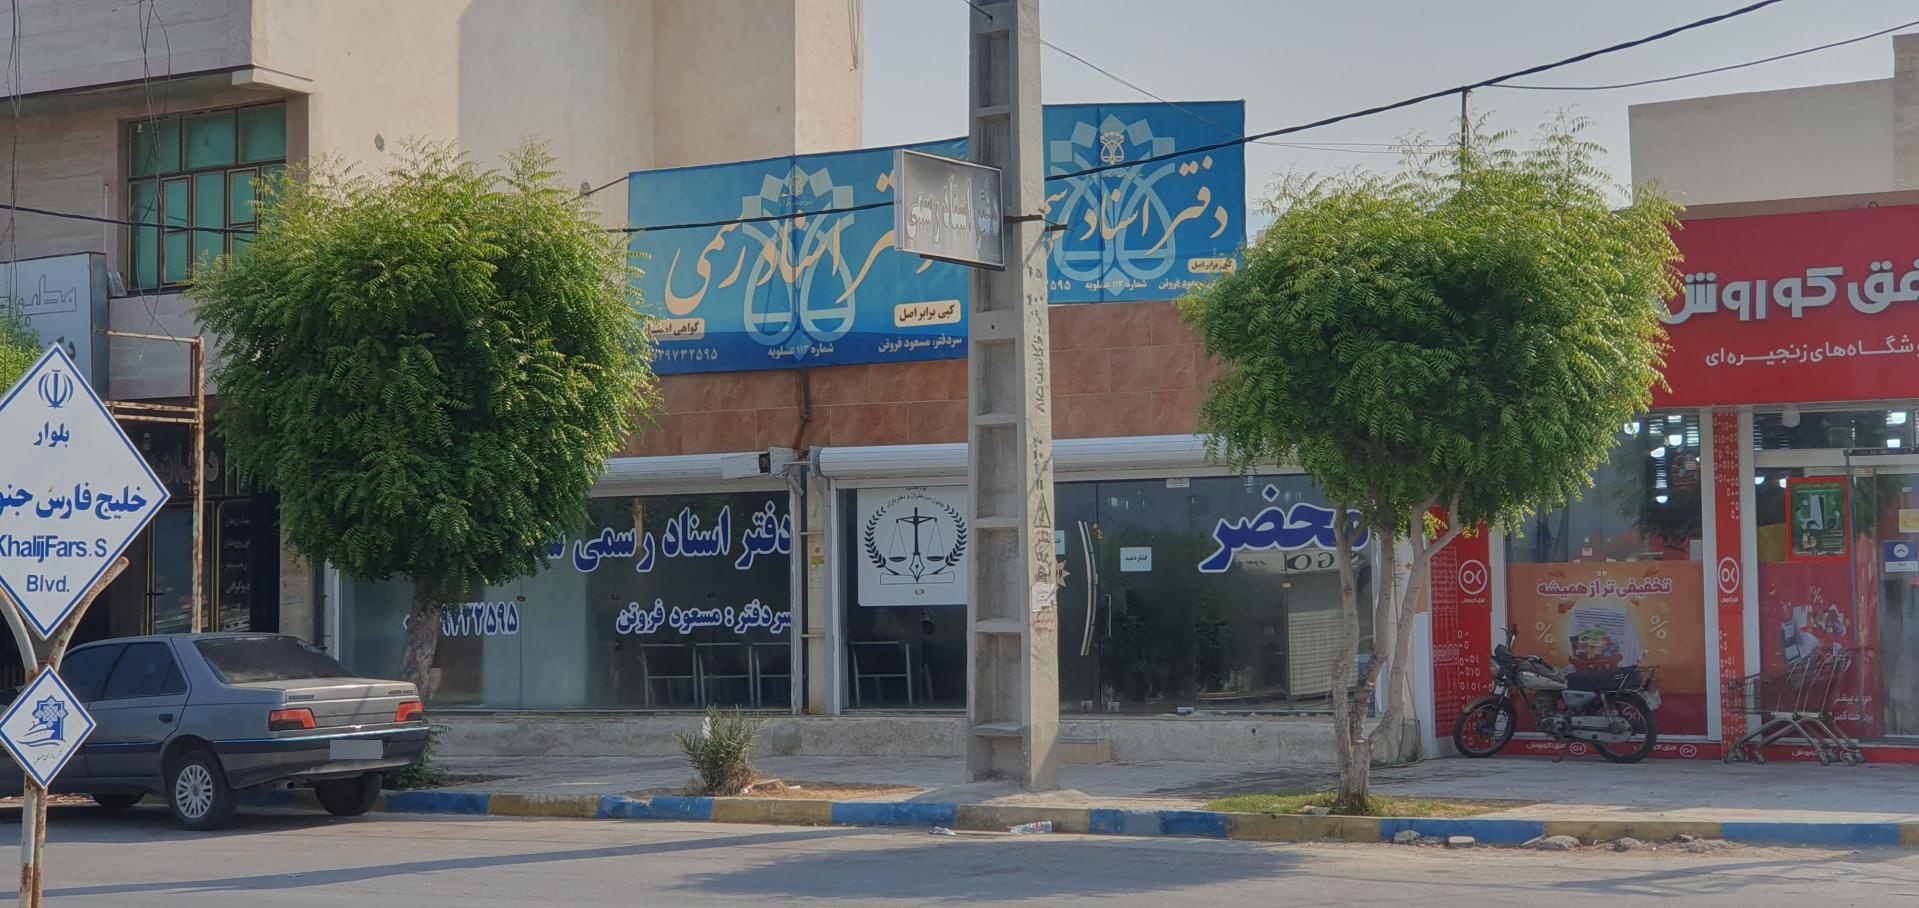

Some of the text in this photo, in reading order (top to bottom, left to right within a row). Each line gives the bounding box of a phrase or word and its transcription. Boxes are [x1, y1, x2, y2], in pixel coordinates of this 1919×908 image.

[905, 190, 940, 244] رسمی
[943, 174, 972, 232] اسناد
[1079, 186, 1150, 242] اسناد
[1145, 155, 1228, 257] دفتر
[664, 212, 746, 316] رسمی
[757, 207, 841, 287] اسناد
[1125, 279, 1147, 291] شماره
[673, 321, 700, 336] گواهی
[899, 304, 954, 321] کپی برابر اصل
[811, 342, 834, 357] شماره
[878, 337, 902, 353] فروتن
[903, 339, 931, 351] مسعود
[33, 422, 70, 447] بلوار
[35, 482, 92, 519] فارس
[95, 485, 148, 520] خلیج
[662, 505, 731, 558] اسناد
[734, 500, 791, 570] دفتر
[1199, 484, 1371, 573] محضر
[26, 574, 70, 592] Blvd.
[1536, 580, 1588, 600] همیشه
[1589, 579, 1600, 599] از
[616, 597, 666, 634] فروتن
[669, 607, 722, 634] مسعود
